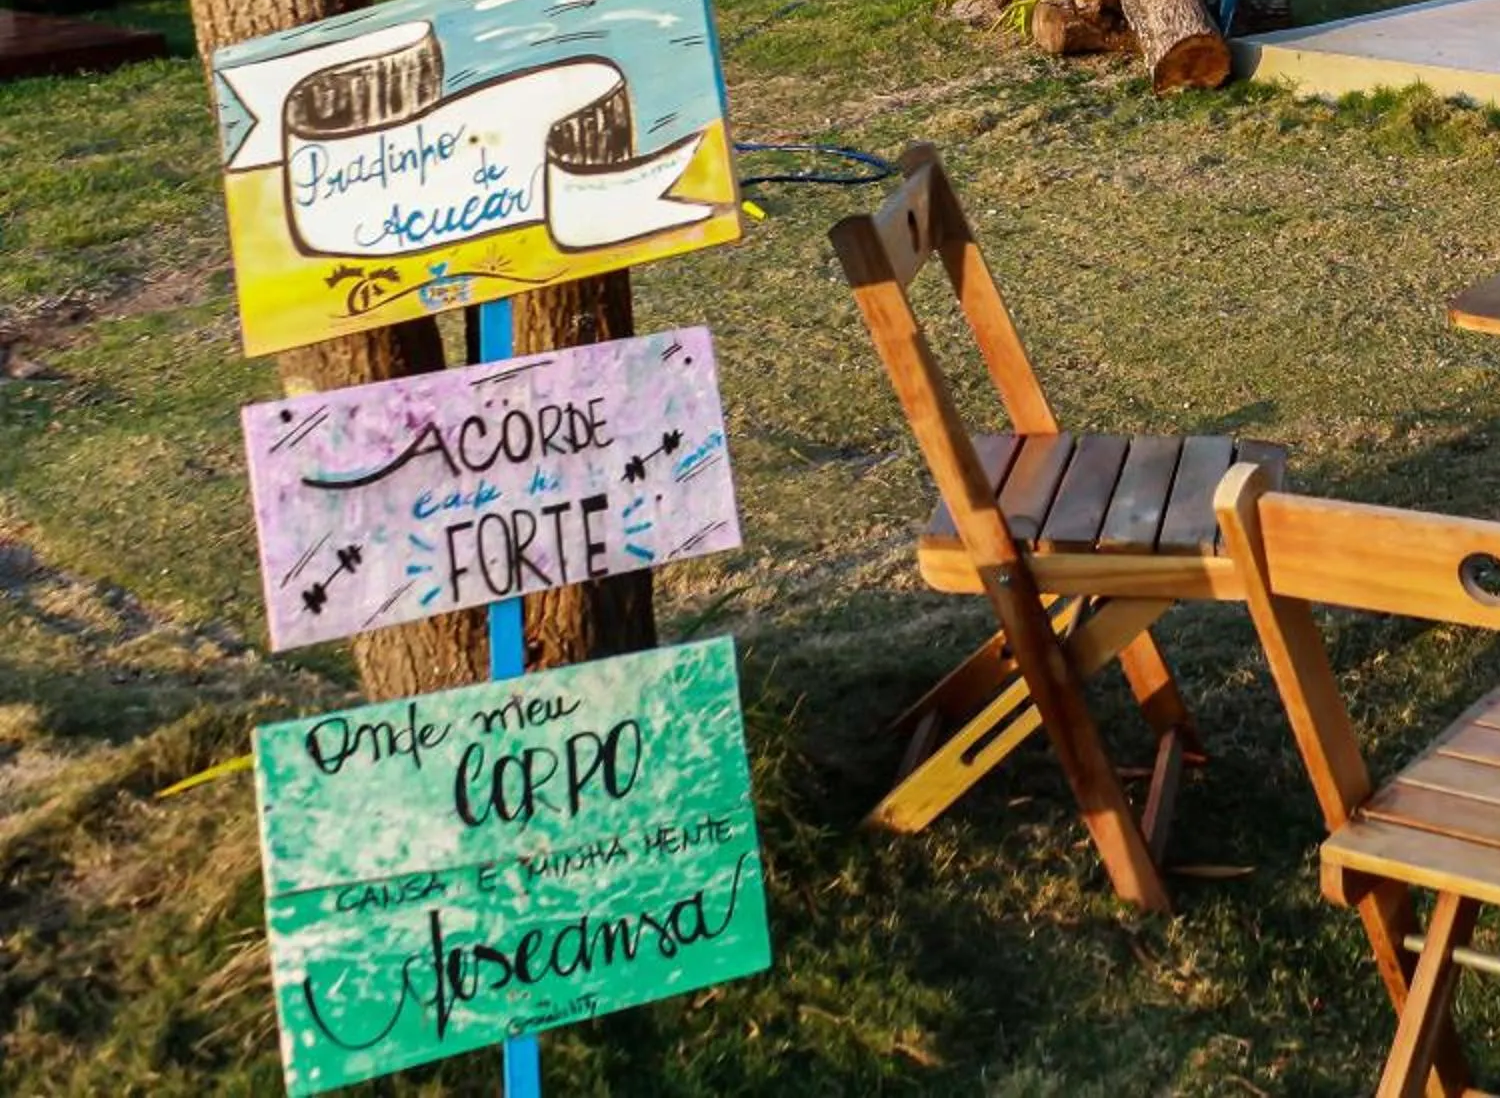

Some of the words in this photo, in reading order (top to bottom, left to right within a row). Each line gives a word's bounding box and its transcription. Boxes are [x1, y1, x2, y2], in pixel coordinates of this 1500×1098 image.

[473, 146, 509, 189] de
[443, 492, 610, 604] FORTE
[305, 703, 451, 774] Onde
[472, 691, 582, 736] meu
[453, 718, 643, 828] CORPO
